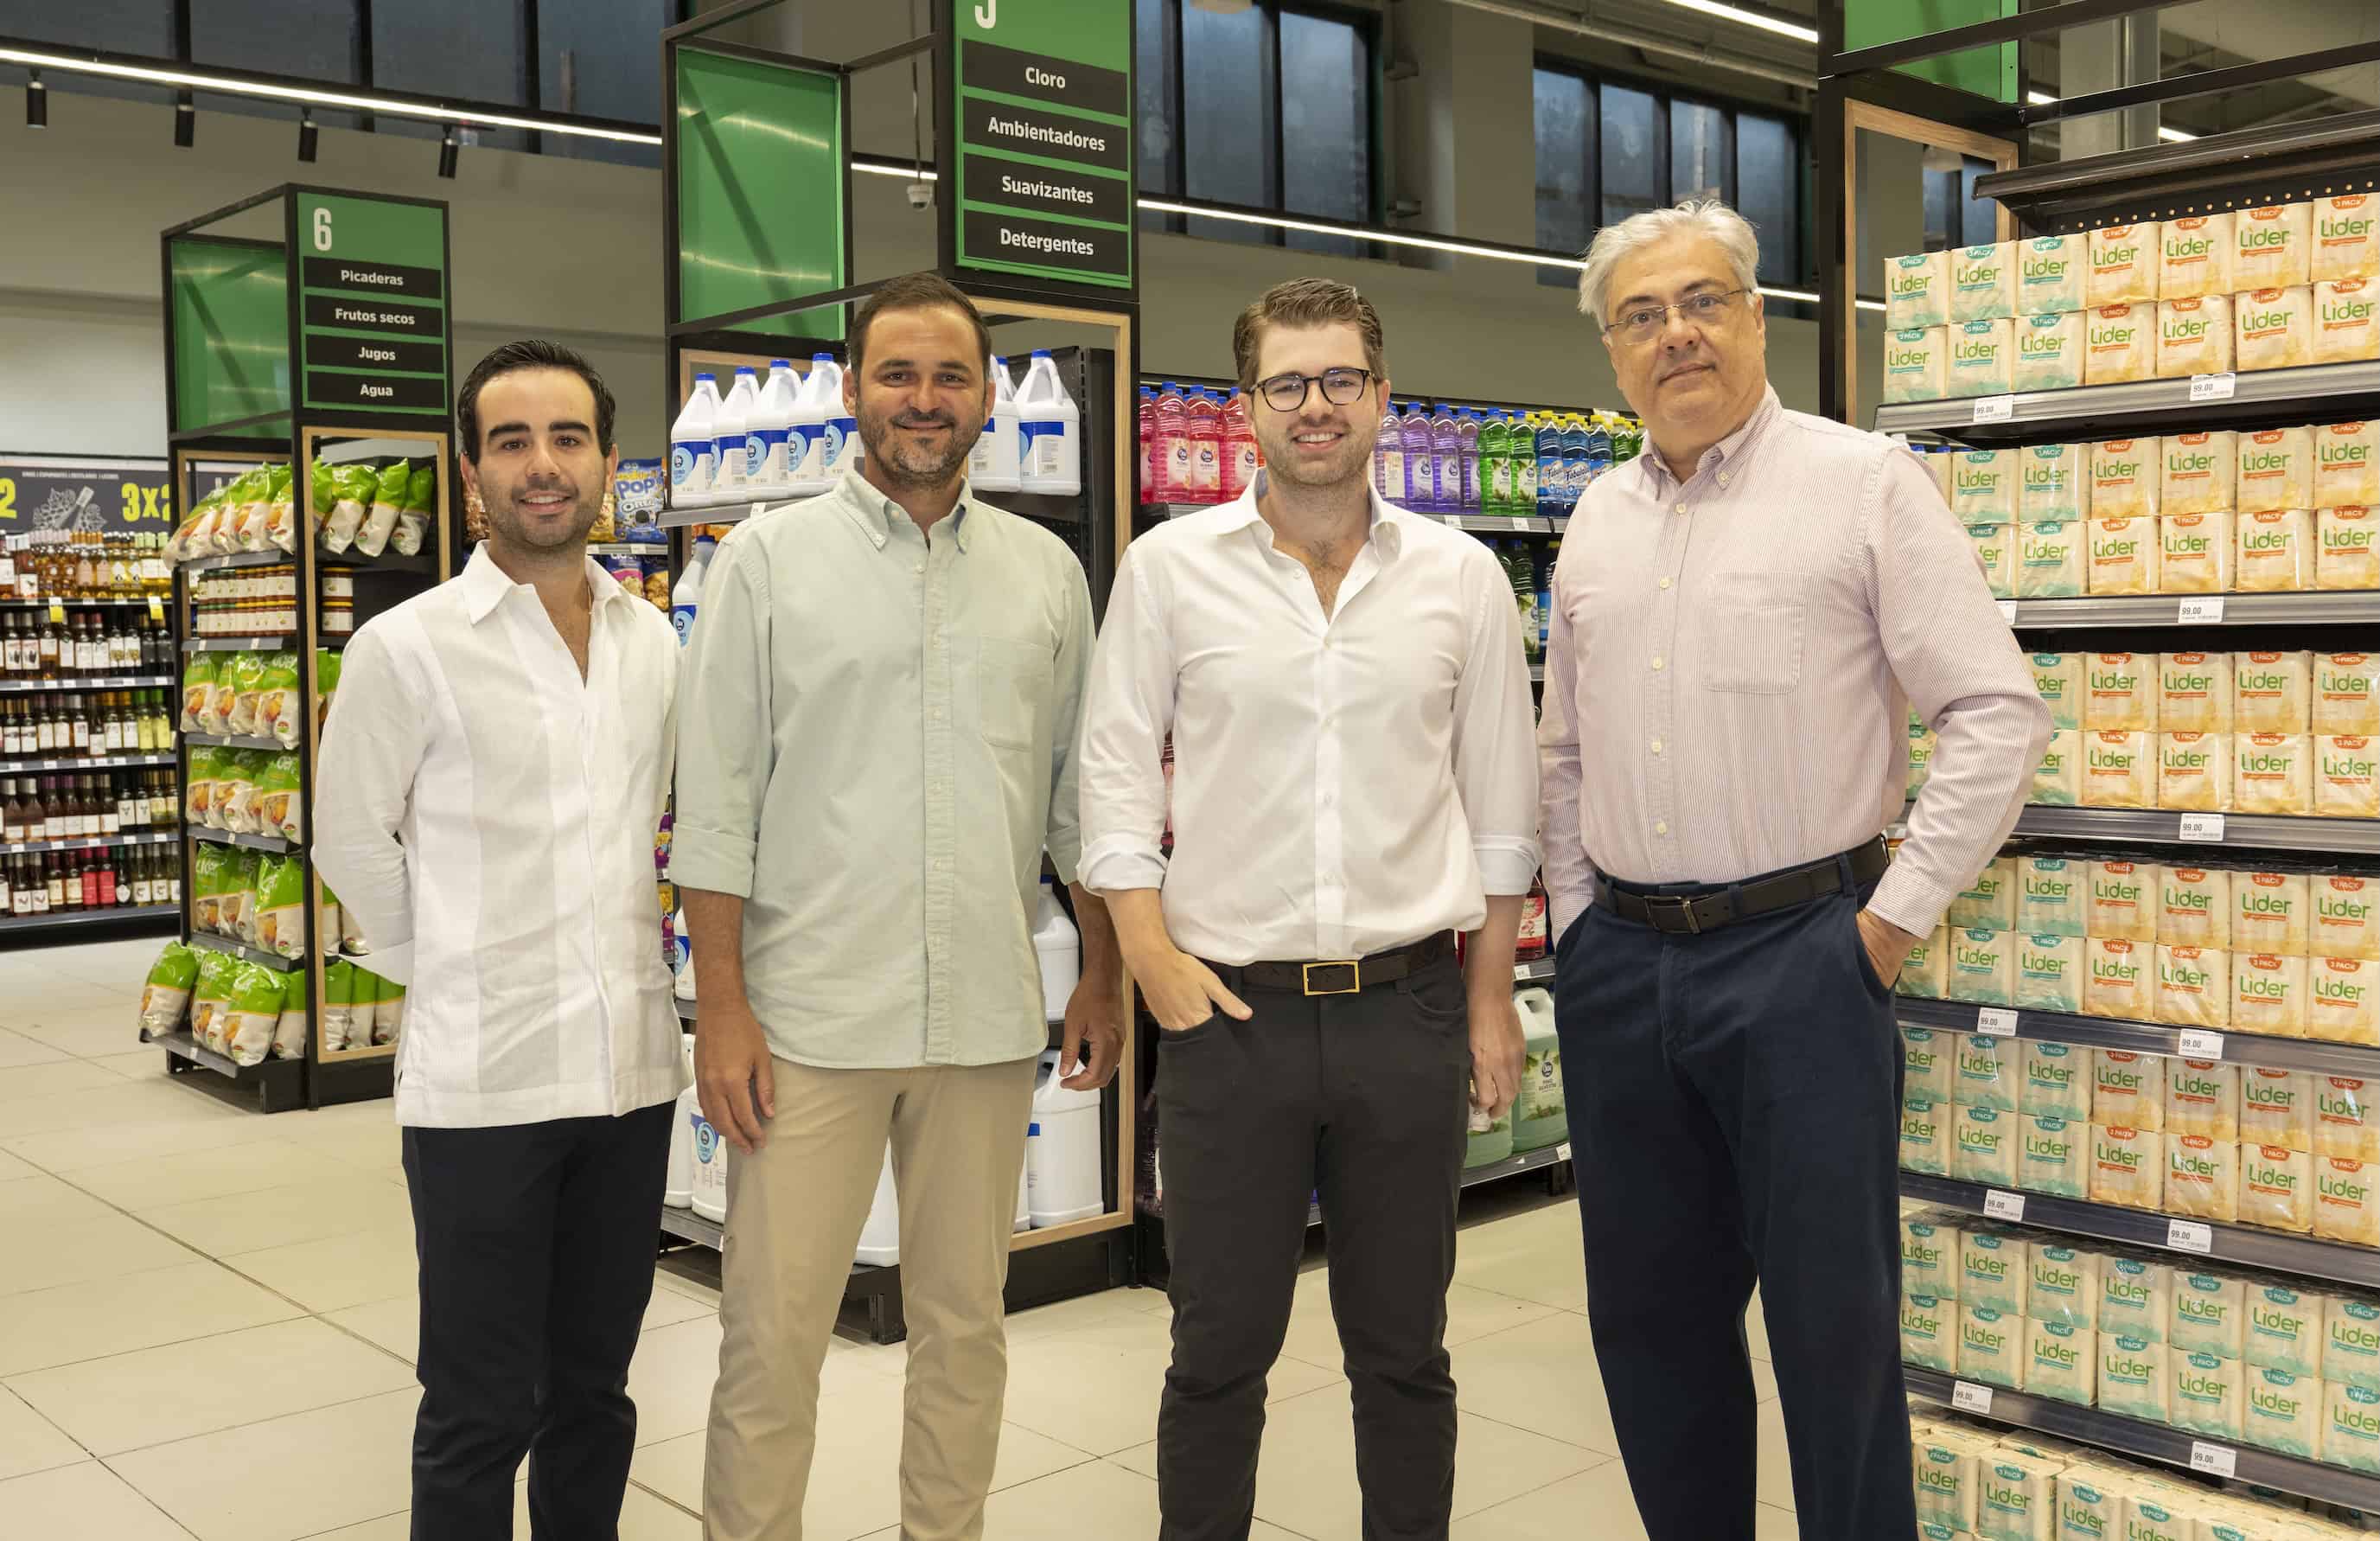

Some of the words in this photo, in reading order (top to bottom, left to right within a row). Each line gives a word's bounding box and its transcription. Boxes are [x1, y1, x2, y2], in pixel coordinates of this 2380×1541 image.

[1025, 67, 1065, 88] Cloro
[988, 117, 1105, 151] Ambientadores
[1002, 176, 1094, 203] Suavizantes
[314, 208, 332, 251] 6
[2240, 227, 2289, 247] Lider
[2320, 216, 2374, 237] Lider
[1000, 228, 1094, 255] Detergentes
[2166, 236, 2213, 256] Lider
[2093, 245, 2139, 266] Lider
[1957, 265, 2001, 284] Lider
[2023, 257, 2068, 276] Lider
[341, 270, 404, 286] Picaderas
[1892, 275, 1932, 292] Lider
[335, 308, 376, 323] Frutos
[380, 311, 415, 325] secos
[2243, 311, 2293, 331] Lider
[2323, 300, 2375, 321] Lider
[2090, 325, 2136, 344] Lider
[2164, 318, 2210, 337] Lider
[1955, 341, 1997, 358] Lider
[2021, 333, 2067, 351] Lider
[359, 347, 396, 361] Jugos
[1889, 348, 1930, 366] Lider
[361, 384, 393, 397] Agua
[2169, 451, 2215, 471] Lider
[2243, 451, 2290, 471] Lider
[2321, 443, 2370, 462] Lider
[1957, 470, 2000, 488] Lider
[2025, 464, 2068, 483] Lider
[2096, 459, 2140, 478] Lider
[2166, 533, 2210, 552] Lider
[2243, 530, 2293, 549] Lider
[2324, 526, 2375, 547] Lider
[2025, 540, 2068, 558] Lider
[2094, 539, 2137, 557] Lider
[2034, 671, 2067, 691] der
[2091, 668, 2136, 689] Lider
[2164, 671, 2213, 690] Lider
[2239, 669, 2288, 689] Lider
[2090, 746, 2135, 767] Lider
[2164, 747, 2210, 767] Lider
[2241, 749, 2292, 770] Lider
[2324, 754, 2376, 776] Lider
[2026, 876, 2072, 896] Lider
[2096, 878, 2141, 899] Lider
[2166, 886, 2212, 908] Lider
[2243, 892, 2293, 913] Lider
[2319, 896, 2370, 918] Lider
[1957, 945, 1999, 964] Lider
[2022, 952, 2068, 971] Lider
[2093, 956, 2139, 978] Lider
[2161, 963, 2209, 985] Lider
[2240, 973, 2289, 996] Lider
[2315, 976, 2366, 1000] Lider
[1906, 1049, 1937, 1066] der
[2029, 1059, 2074, 1081] Lider
[2097, 1065, 2142, 1088] Lider
[2175, 1072, 2221, 1096] Lider
[2246, 1081, 2295, 1104] Lider
[1903, 1115, 1937, 1136] ider
[1959, 1122, 2001, 1148] Lider
[2026, 1135, 2071, 1157] Lider
[2097, 1141, 2142, 1165] Lider
[2249, 1163, 2296, 1188] Lider
[2319, 1175, 2369, 1200] Lider
[1901, 1239, 1942, 1261] Lider
[1966, 1252, 2008, 1275] Lider
[2035, 1260, 2080, 1287] Lider
[2106, 1275, 2151, 1301] Lider
[2179, 1292, 2227, 1319] Lider
[1901, 1309, 1940, 1333] Lider
[2254, 1305, 2303, 1333] Lider
[1964, 1323, 2006, 1347] Lider
[2035, 1337, 2079, 1363] Lider
[2106, 1353, 2153, 1378] Lider
[2179, 1370, 2227, 1397] Lider
[2252, 1385, 2300, 1414] Lider
[1918, 1466, 1960, 1489] Lider
[1986, 1480, 2031, 1508] Lider
[2064, 1500, 2106, 1530] Lider
